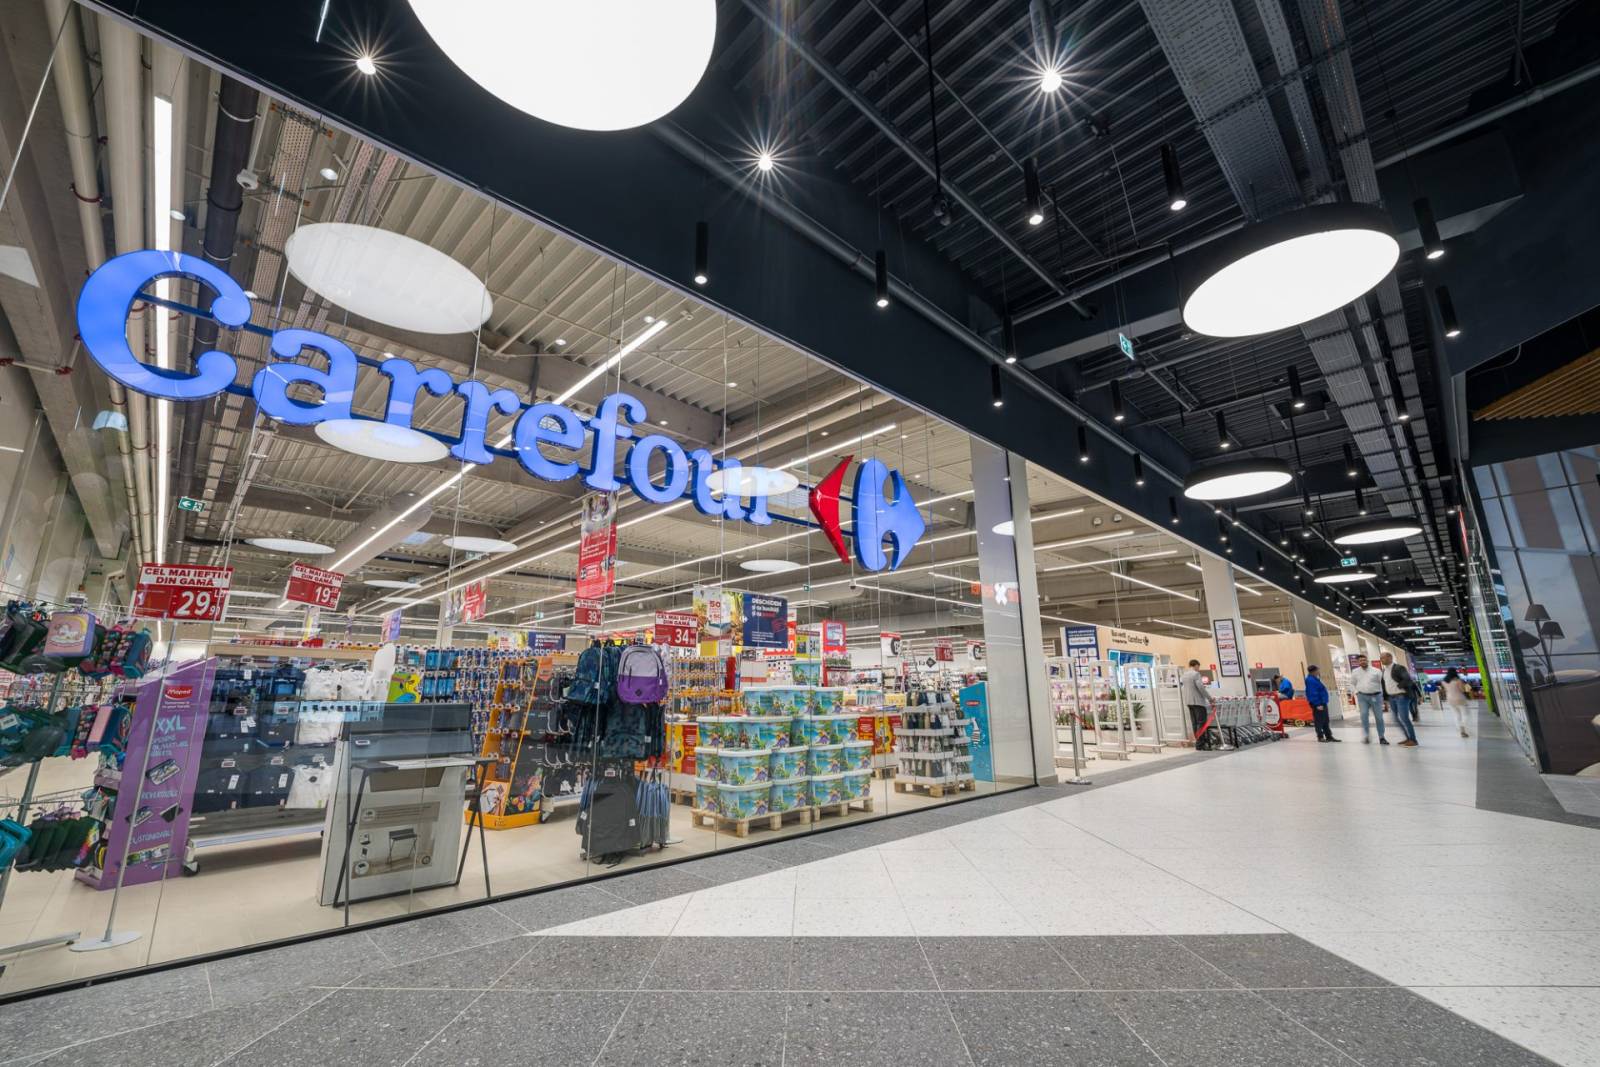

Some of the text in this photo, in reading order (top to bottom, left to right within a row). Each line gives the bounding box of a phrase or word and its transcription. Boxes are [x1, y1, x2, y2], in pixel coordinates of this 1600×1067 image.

[77, 249, 784, 527] Carrefour
[144, 568, 230, 580] CEL MAI IEFTIN
[155, 576, 177, 585] DIN
[176, 590, 211, 616] 29
[314, 586, 331, 603] 19
[587, 610, 597, 623] 39
[674, 628, 689, 645] 34
[156, 714, 187, 735] XXL
